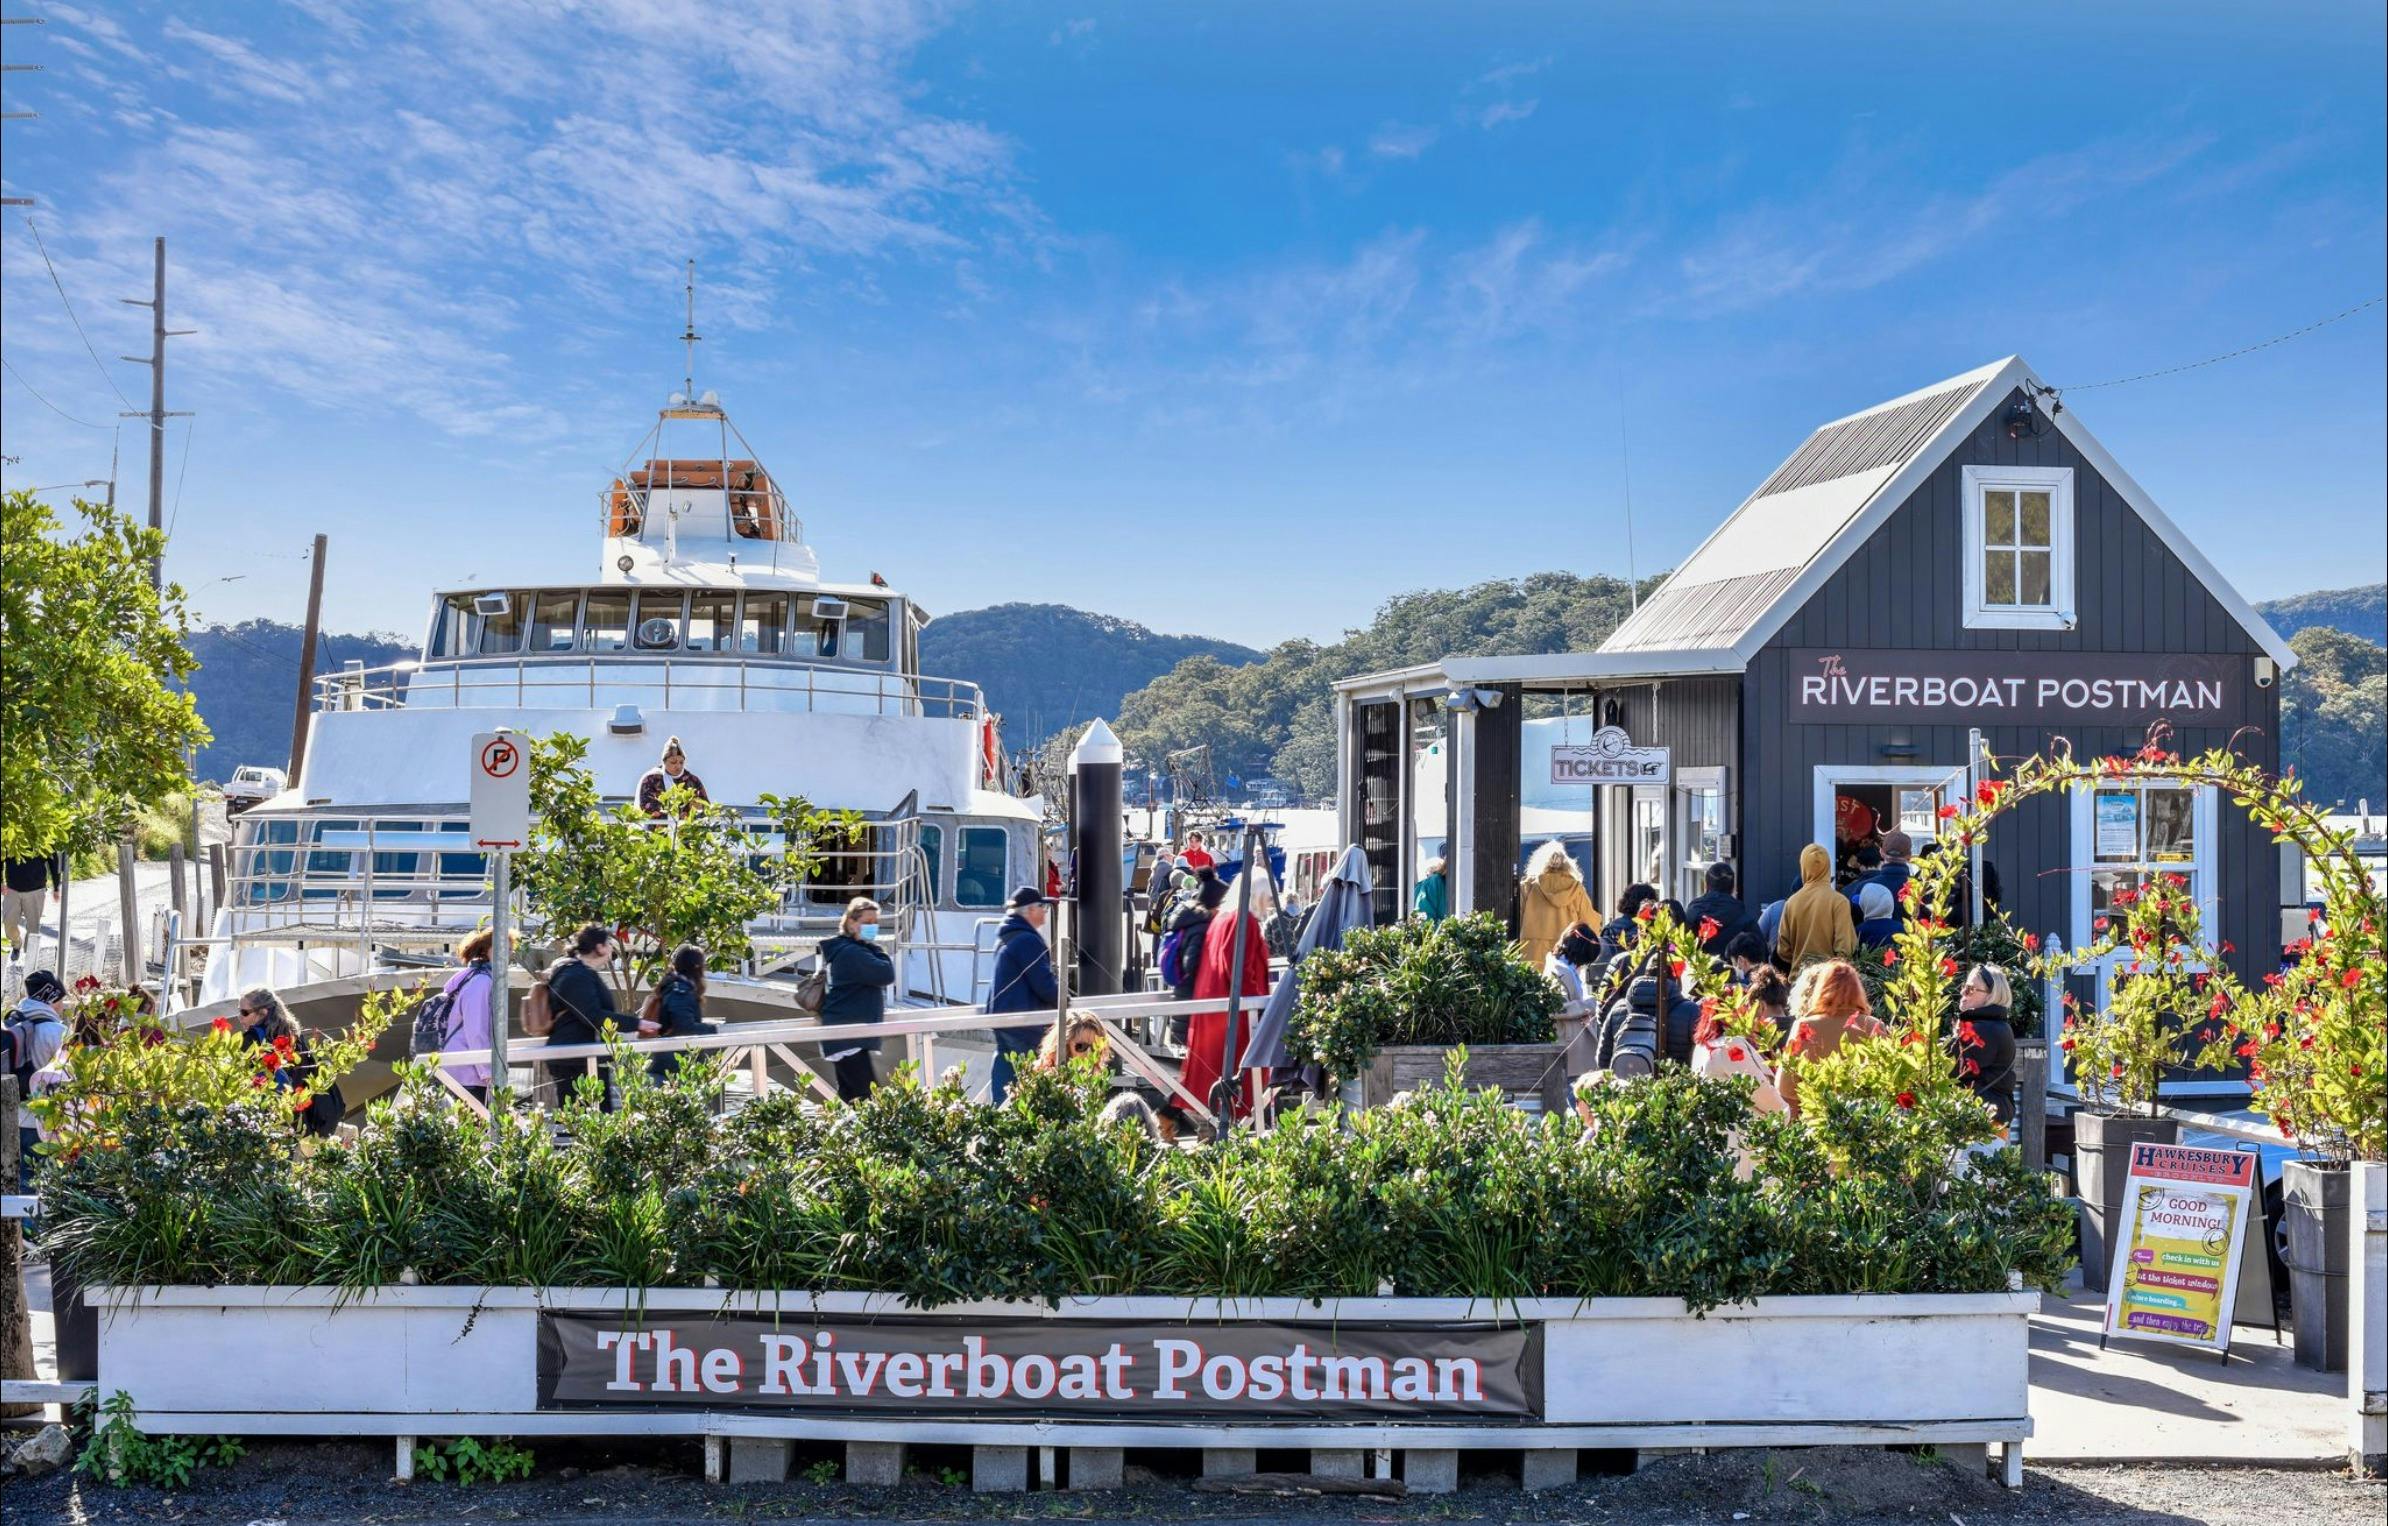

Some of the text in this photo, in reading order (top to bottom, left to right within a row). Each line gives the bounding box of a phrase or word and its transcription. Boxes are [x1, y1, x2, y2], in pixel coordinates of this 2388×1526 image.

[1818, 654, 1847, 677] The
[1802, 676, 2222, 709] RIVERBOAT POSTMAN
[1555, 760, 1639, 778] TICKETS
[2135, 1147, 2248, 1175] HAWKESBURY
[2159, 1160, 2226, 1174] CRUISES
[2168, 1198, 2208, 1213] GOOD
[2150, 1212, 2221, 1229] MORNING!
[2162, 1252, 2183, 1262] check
[2184, 1255, 2192, 1263] in
[2193, 1256, 2210, 1265] with
[2148, 1273, 2161, 1282] the
[2163, 1275, 2186, 1286] ticket
[2188, 1279, 2218, 1289] window
[2146, 1314, 2160, 1326] then
[597, 1330, 1484, 1403] The Riverboat Postman
